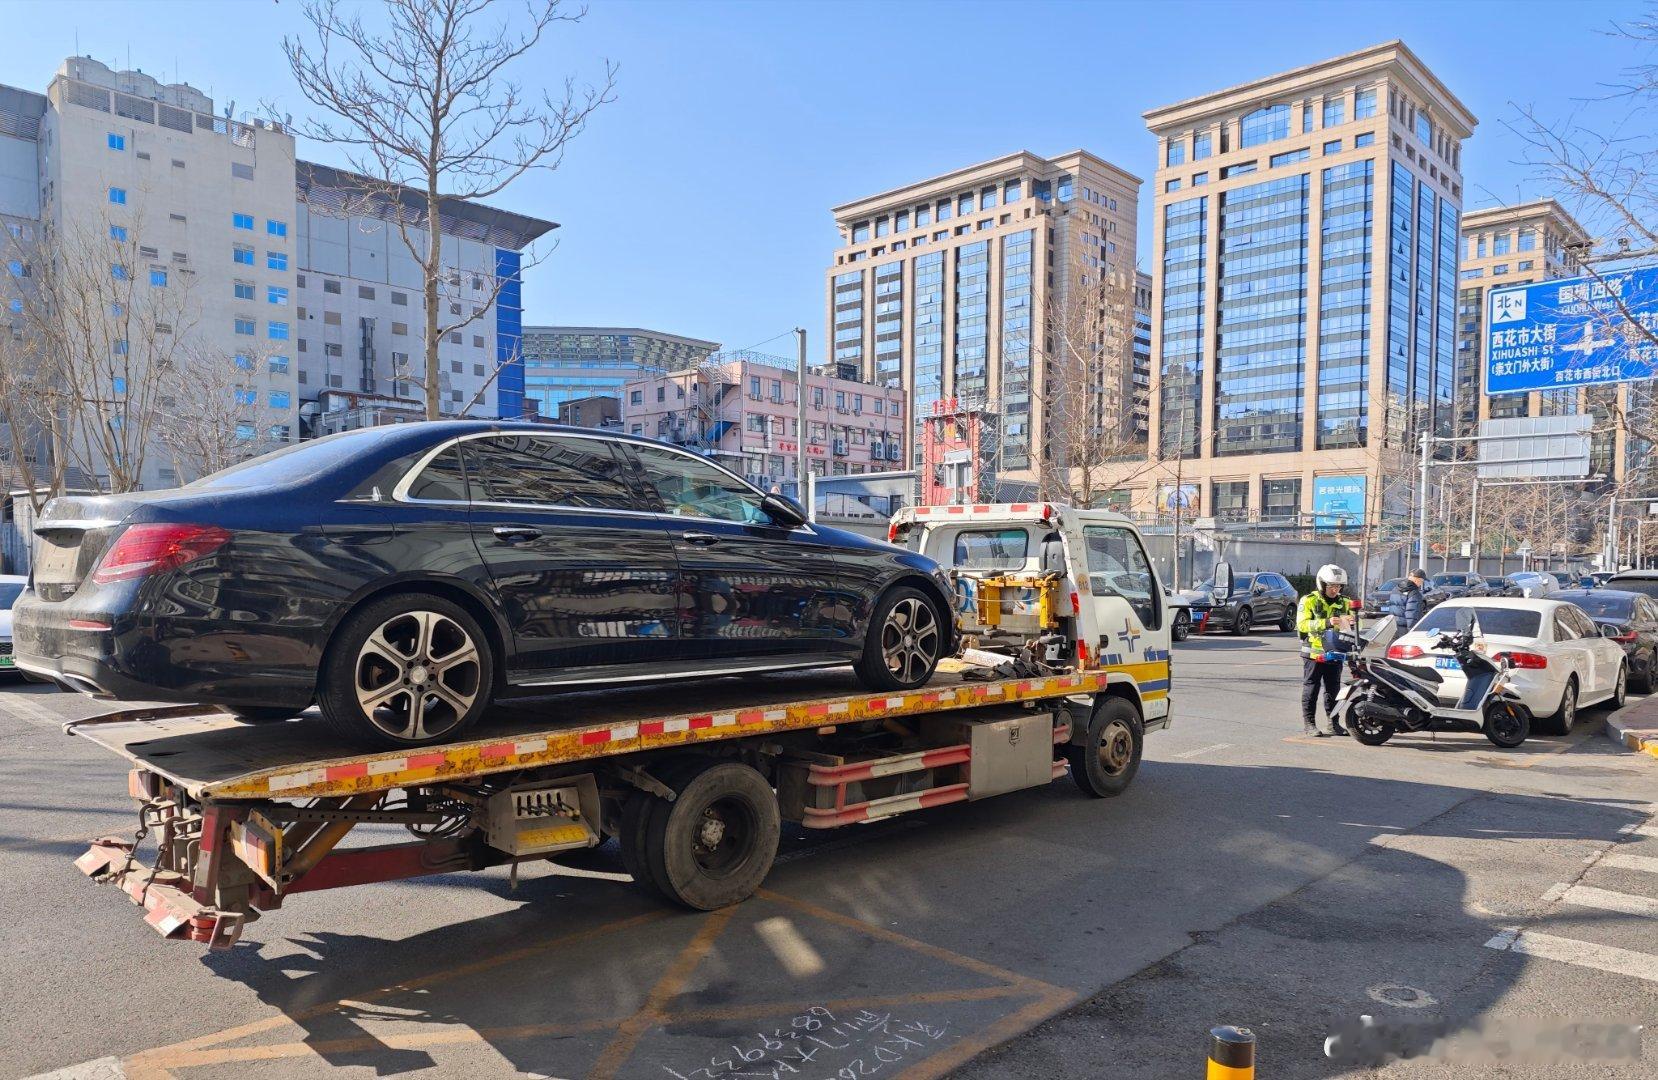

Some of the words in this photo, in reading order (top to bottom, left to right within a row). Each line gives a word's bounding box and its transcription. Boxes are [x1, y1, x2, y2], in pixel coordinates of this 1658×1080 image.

[1497, 295, 1511, 309] 北
[1515, 299, 1522, 308] N
[1492, 324, 1557, 349] 西花市大街
[1492, 346, 1538, 361] XIHUASHI
